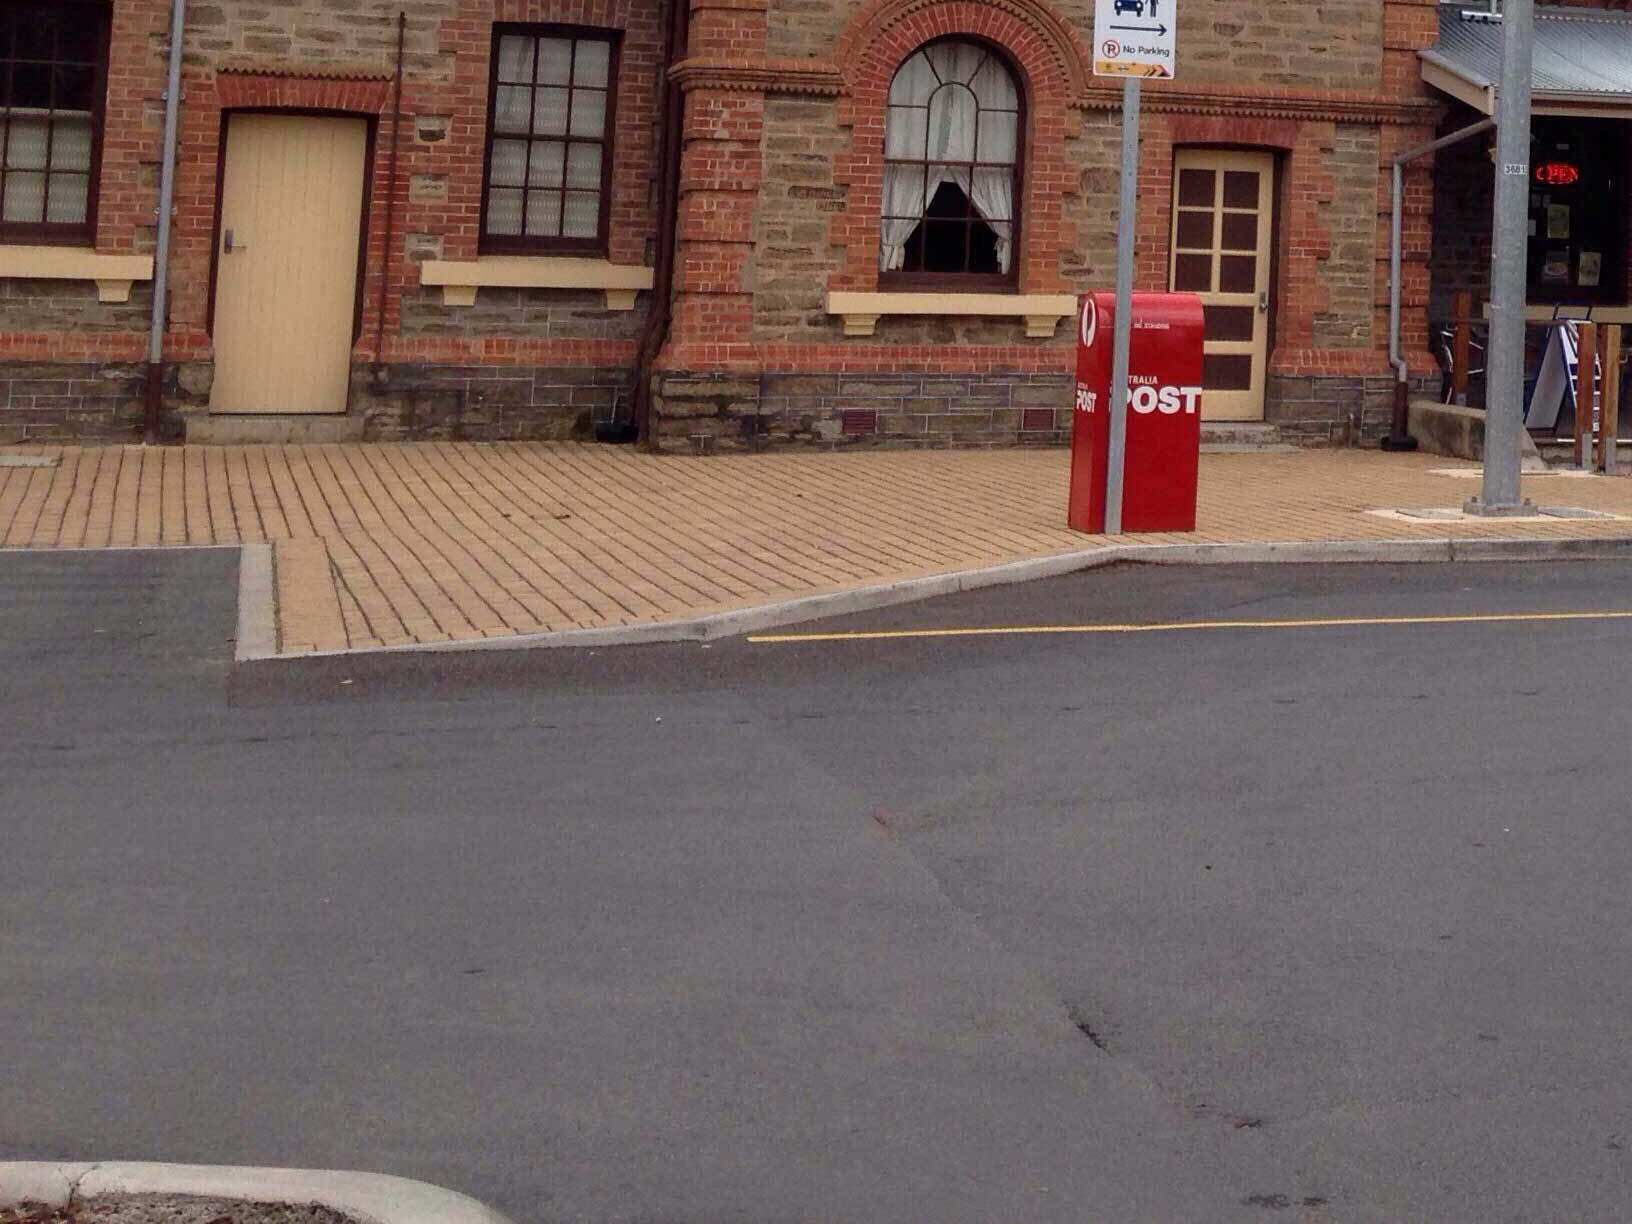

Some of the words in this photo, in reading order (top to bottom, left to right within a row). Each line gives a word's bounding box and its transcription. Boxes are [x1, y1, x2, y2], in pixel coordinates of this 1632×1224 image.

[1123, 45, 1136, 54] No
[1138, 46, 1170, 57] Parking
[1536, 164, 1578, 184] OPEN
[1077, 389, 1097, 413] POST
